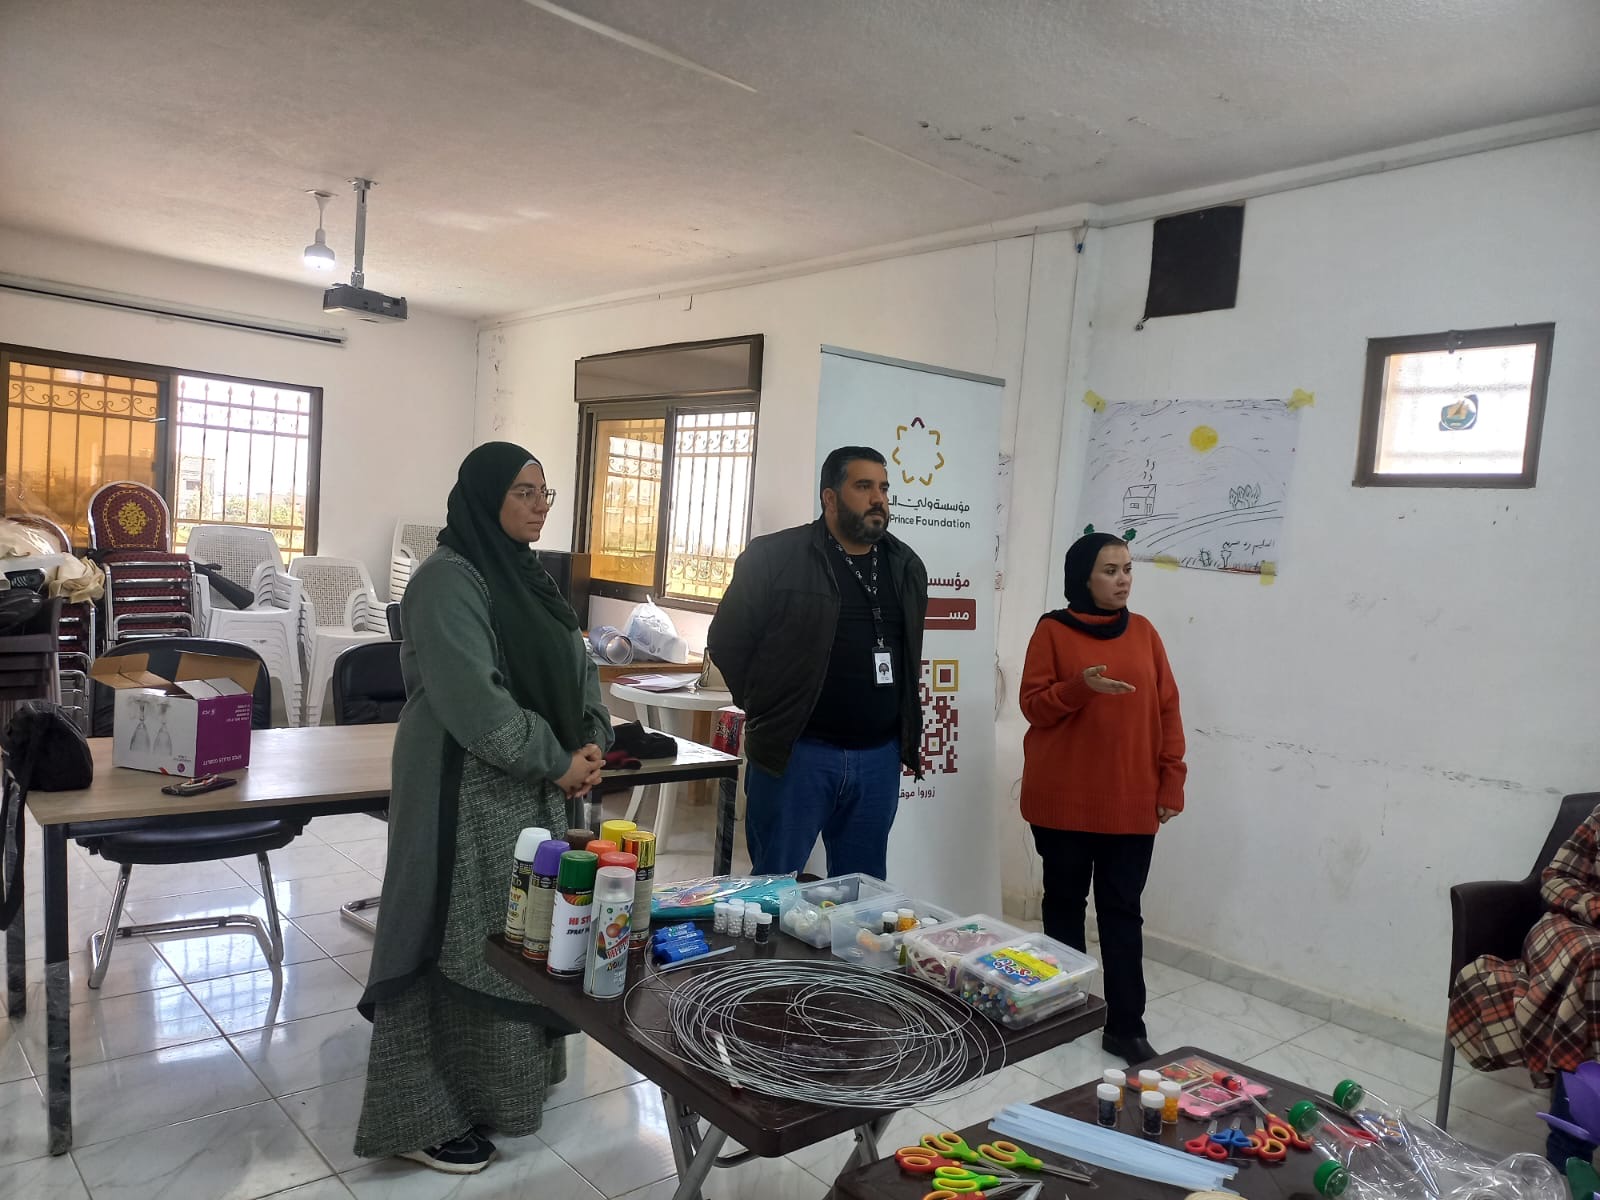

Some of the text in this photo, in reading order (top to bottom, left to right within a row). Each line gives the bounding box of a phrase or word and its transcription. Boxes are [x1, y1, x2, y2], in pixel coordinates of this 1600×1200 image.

[889, 513, 971, 529] Prince Foundation
[928, 572, 969, 590] مؤسس
[924, 611, 970, 621] مس
[899, 789, 915, 799] موق
